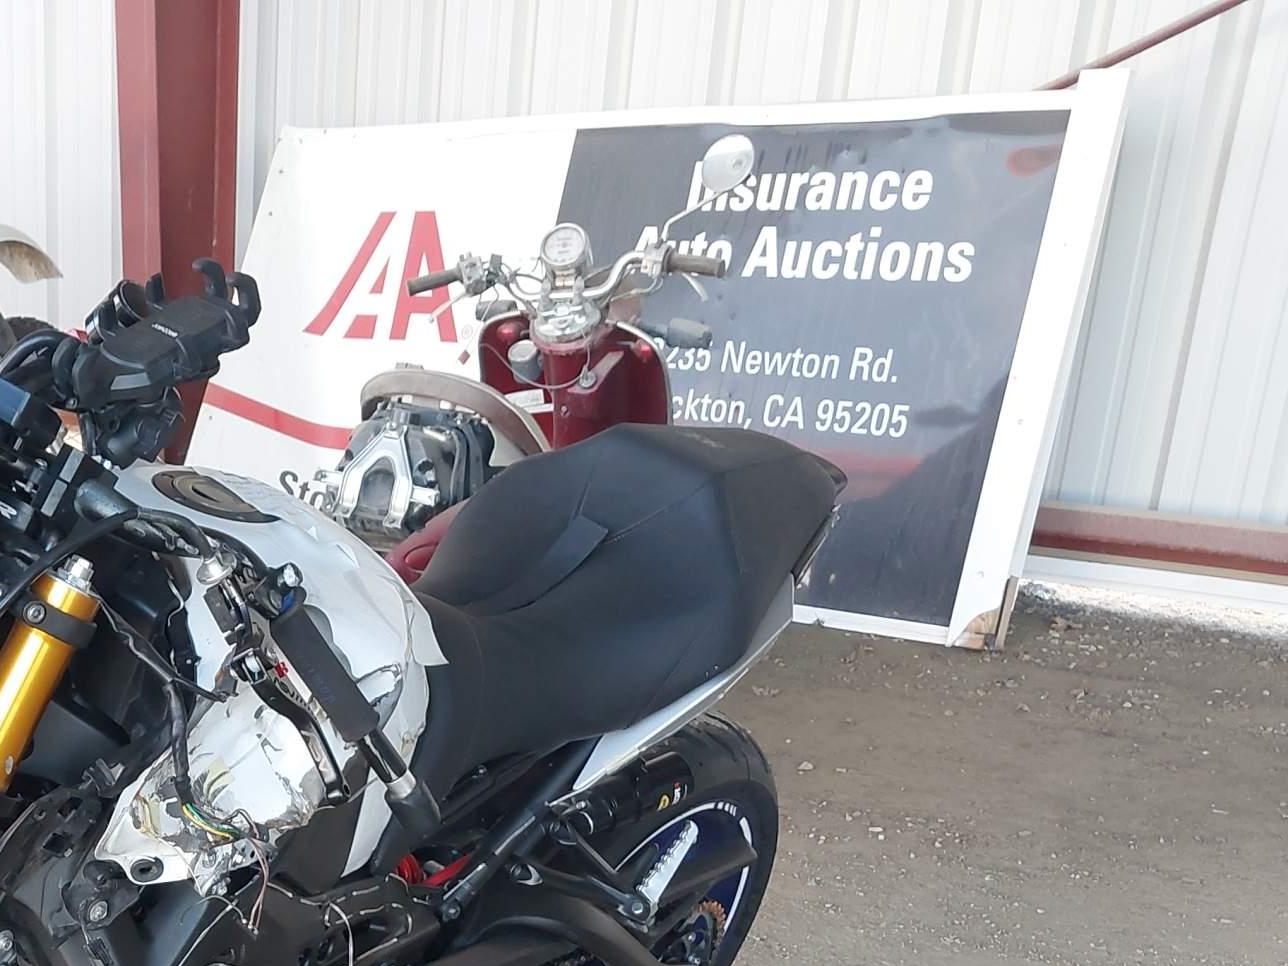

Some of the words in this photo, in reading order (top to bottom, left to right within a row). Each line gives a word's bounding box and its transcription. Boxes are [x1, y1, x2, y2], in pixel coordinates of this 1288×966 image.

[741, 226, 975, 283] Auctions
[653, 336, 713, 371] 235
[720, 339, 841, 379] Newton
[848, 346, 899, 384] Rd.
[671, 388, 753, 430] ckton,
[762, 393, 805, 430] CA
[814, 398, 911, 438] 95205
